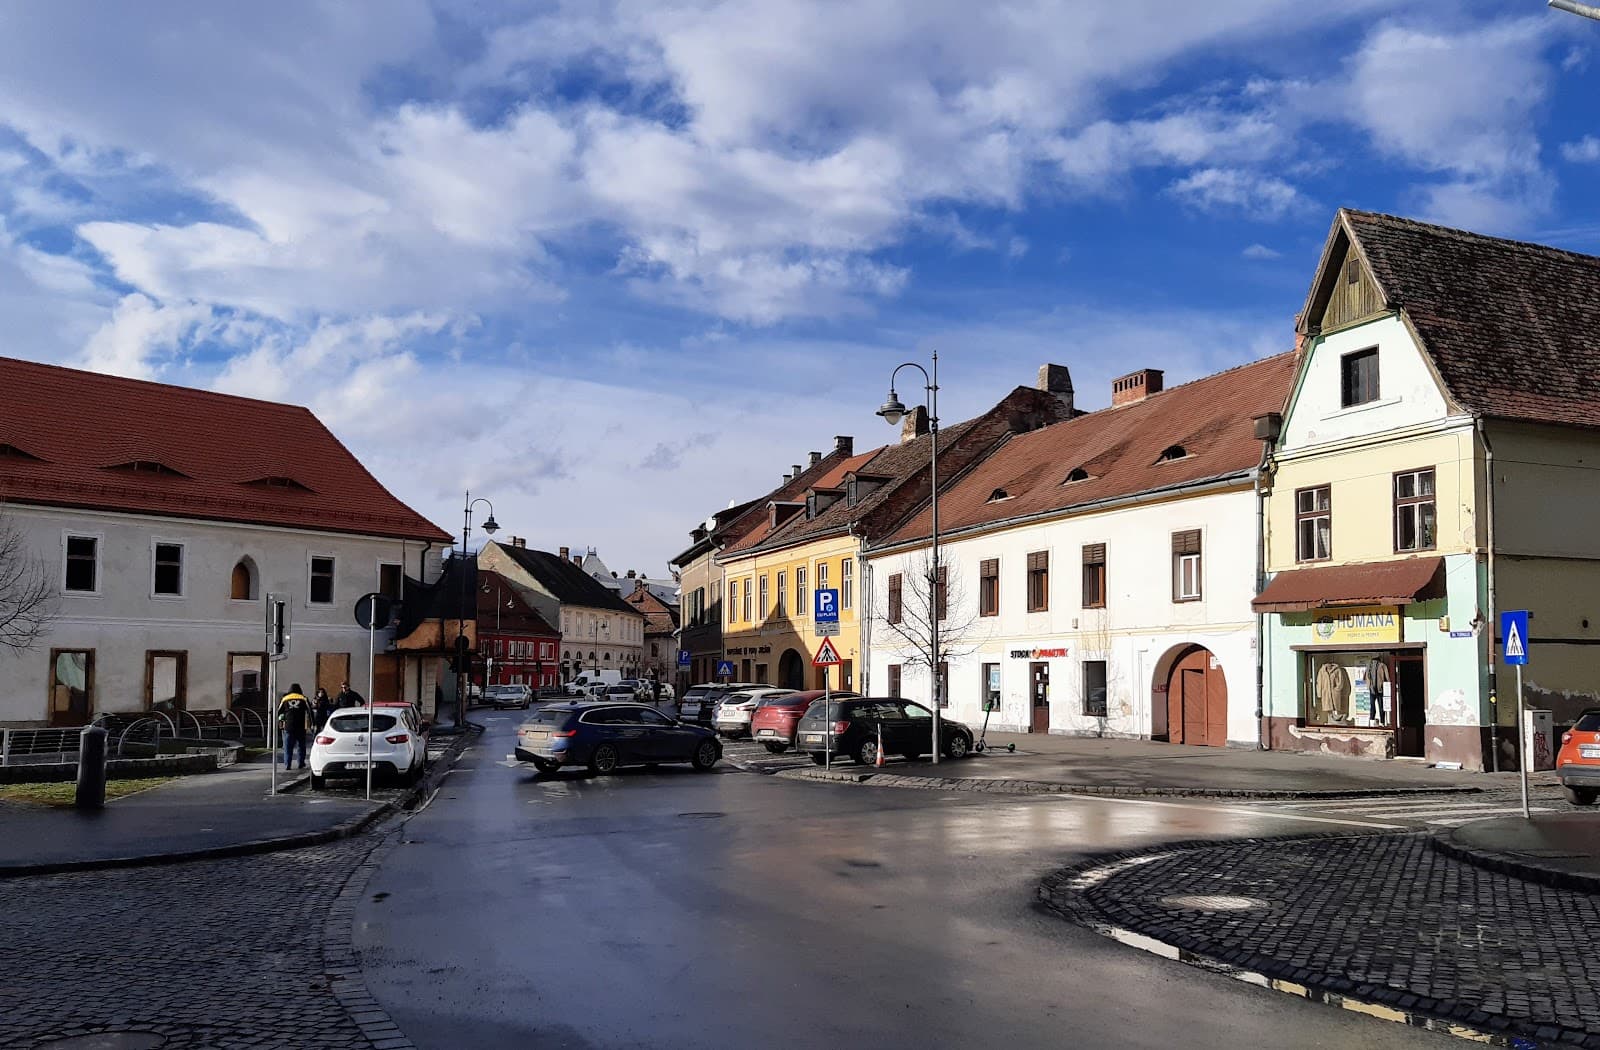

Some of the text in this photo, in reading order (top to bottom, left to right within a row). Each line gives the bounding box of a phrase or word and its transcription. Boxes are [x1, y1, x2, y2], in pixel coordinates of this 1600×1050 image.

[820, 592, 832, 611] P
[1337, 611, 1395, 628] HUMANA
[682, 651, 688, 660] P
